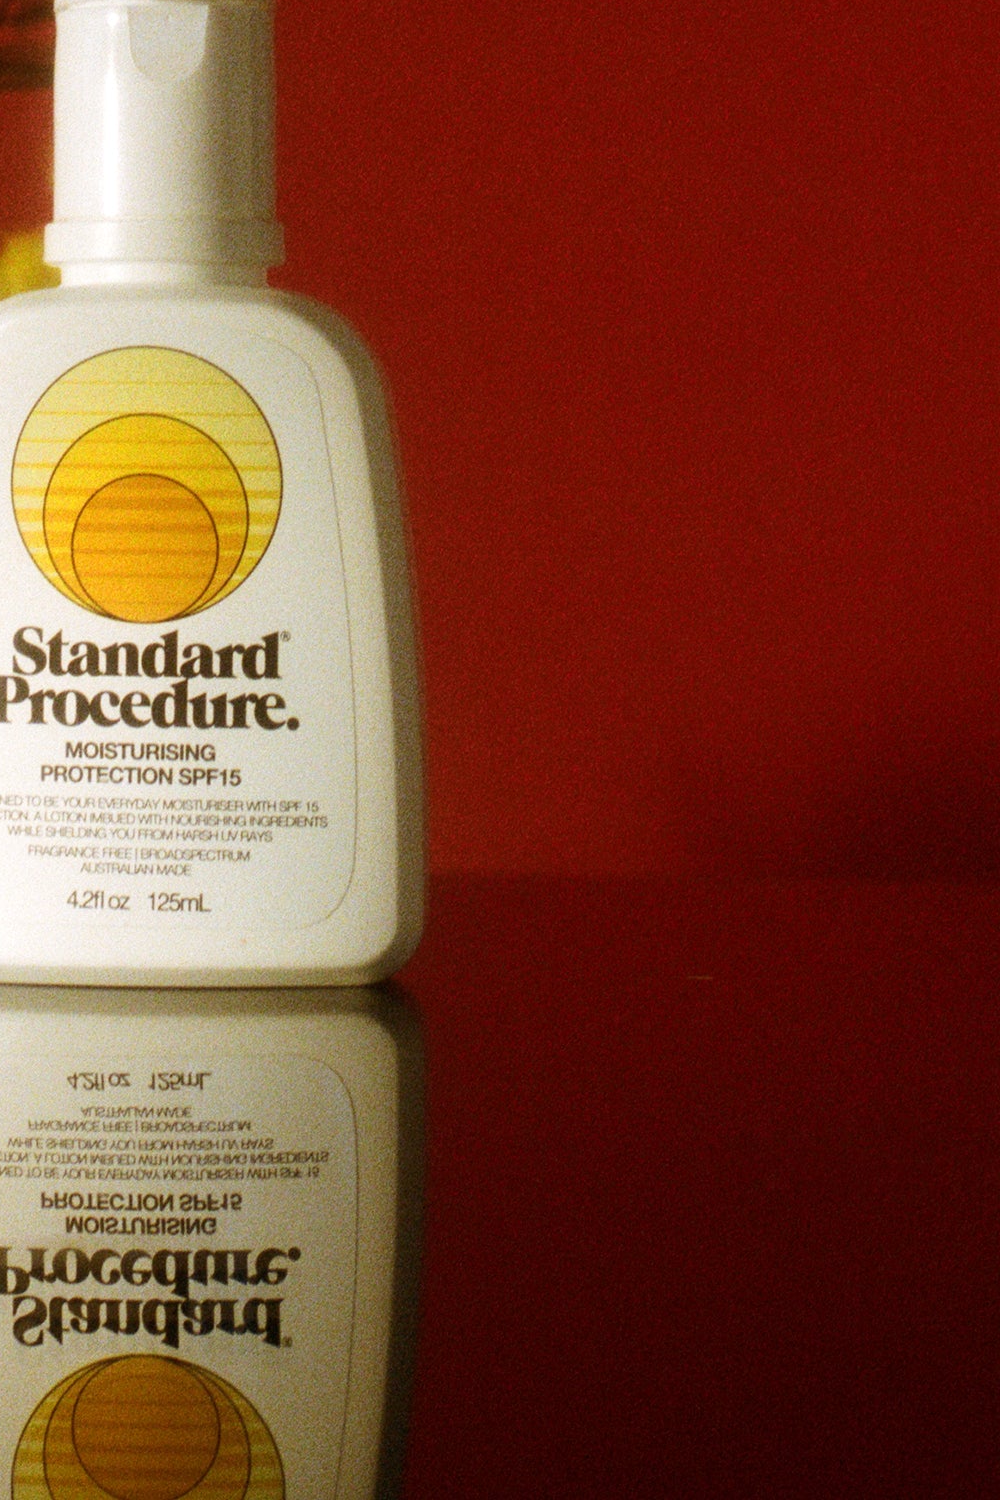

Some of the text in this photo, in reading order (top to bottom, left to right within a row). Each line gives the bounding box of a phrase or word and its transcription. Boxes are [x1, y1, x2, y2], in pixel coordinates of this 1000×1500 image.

[65, 742, 216, 761] MOISTURISING
[41, 766, 241, 786] PROTECTION SPF15
[149, 892, 211, 912] 125mL
